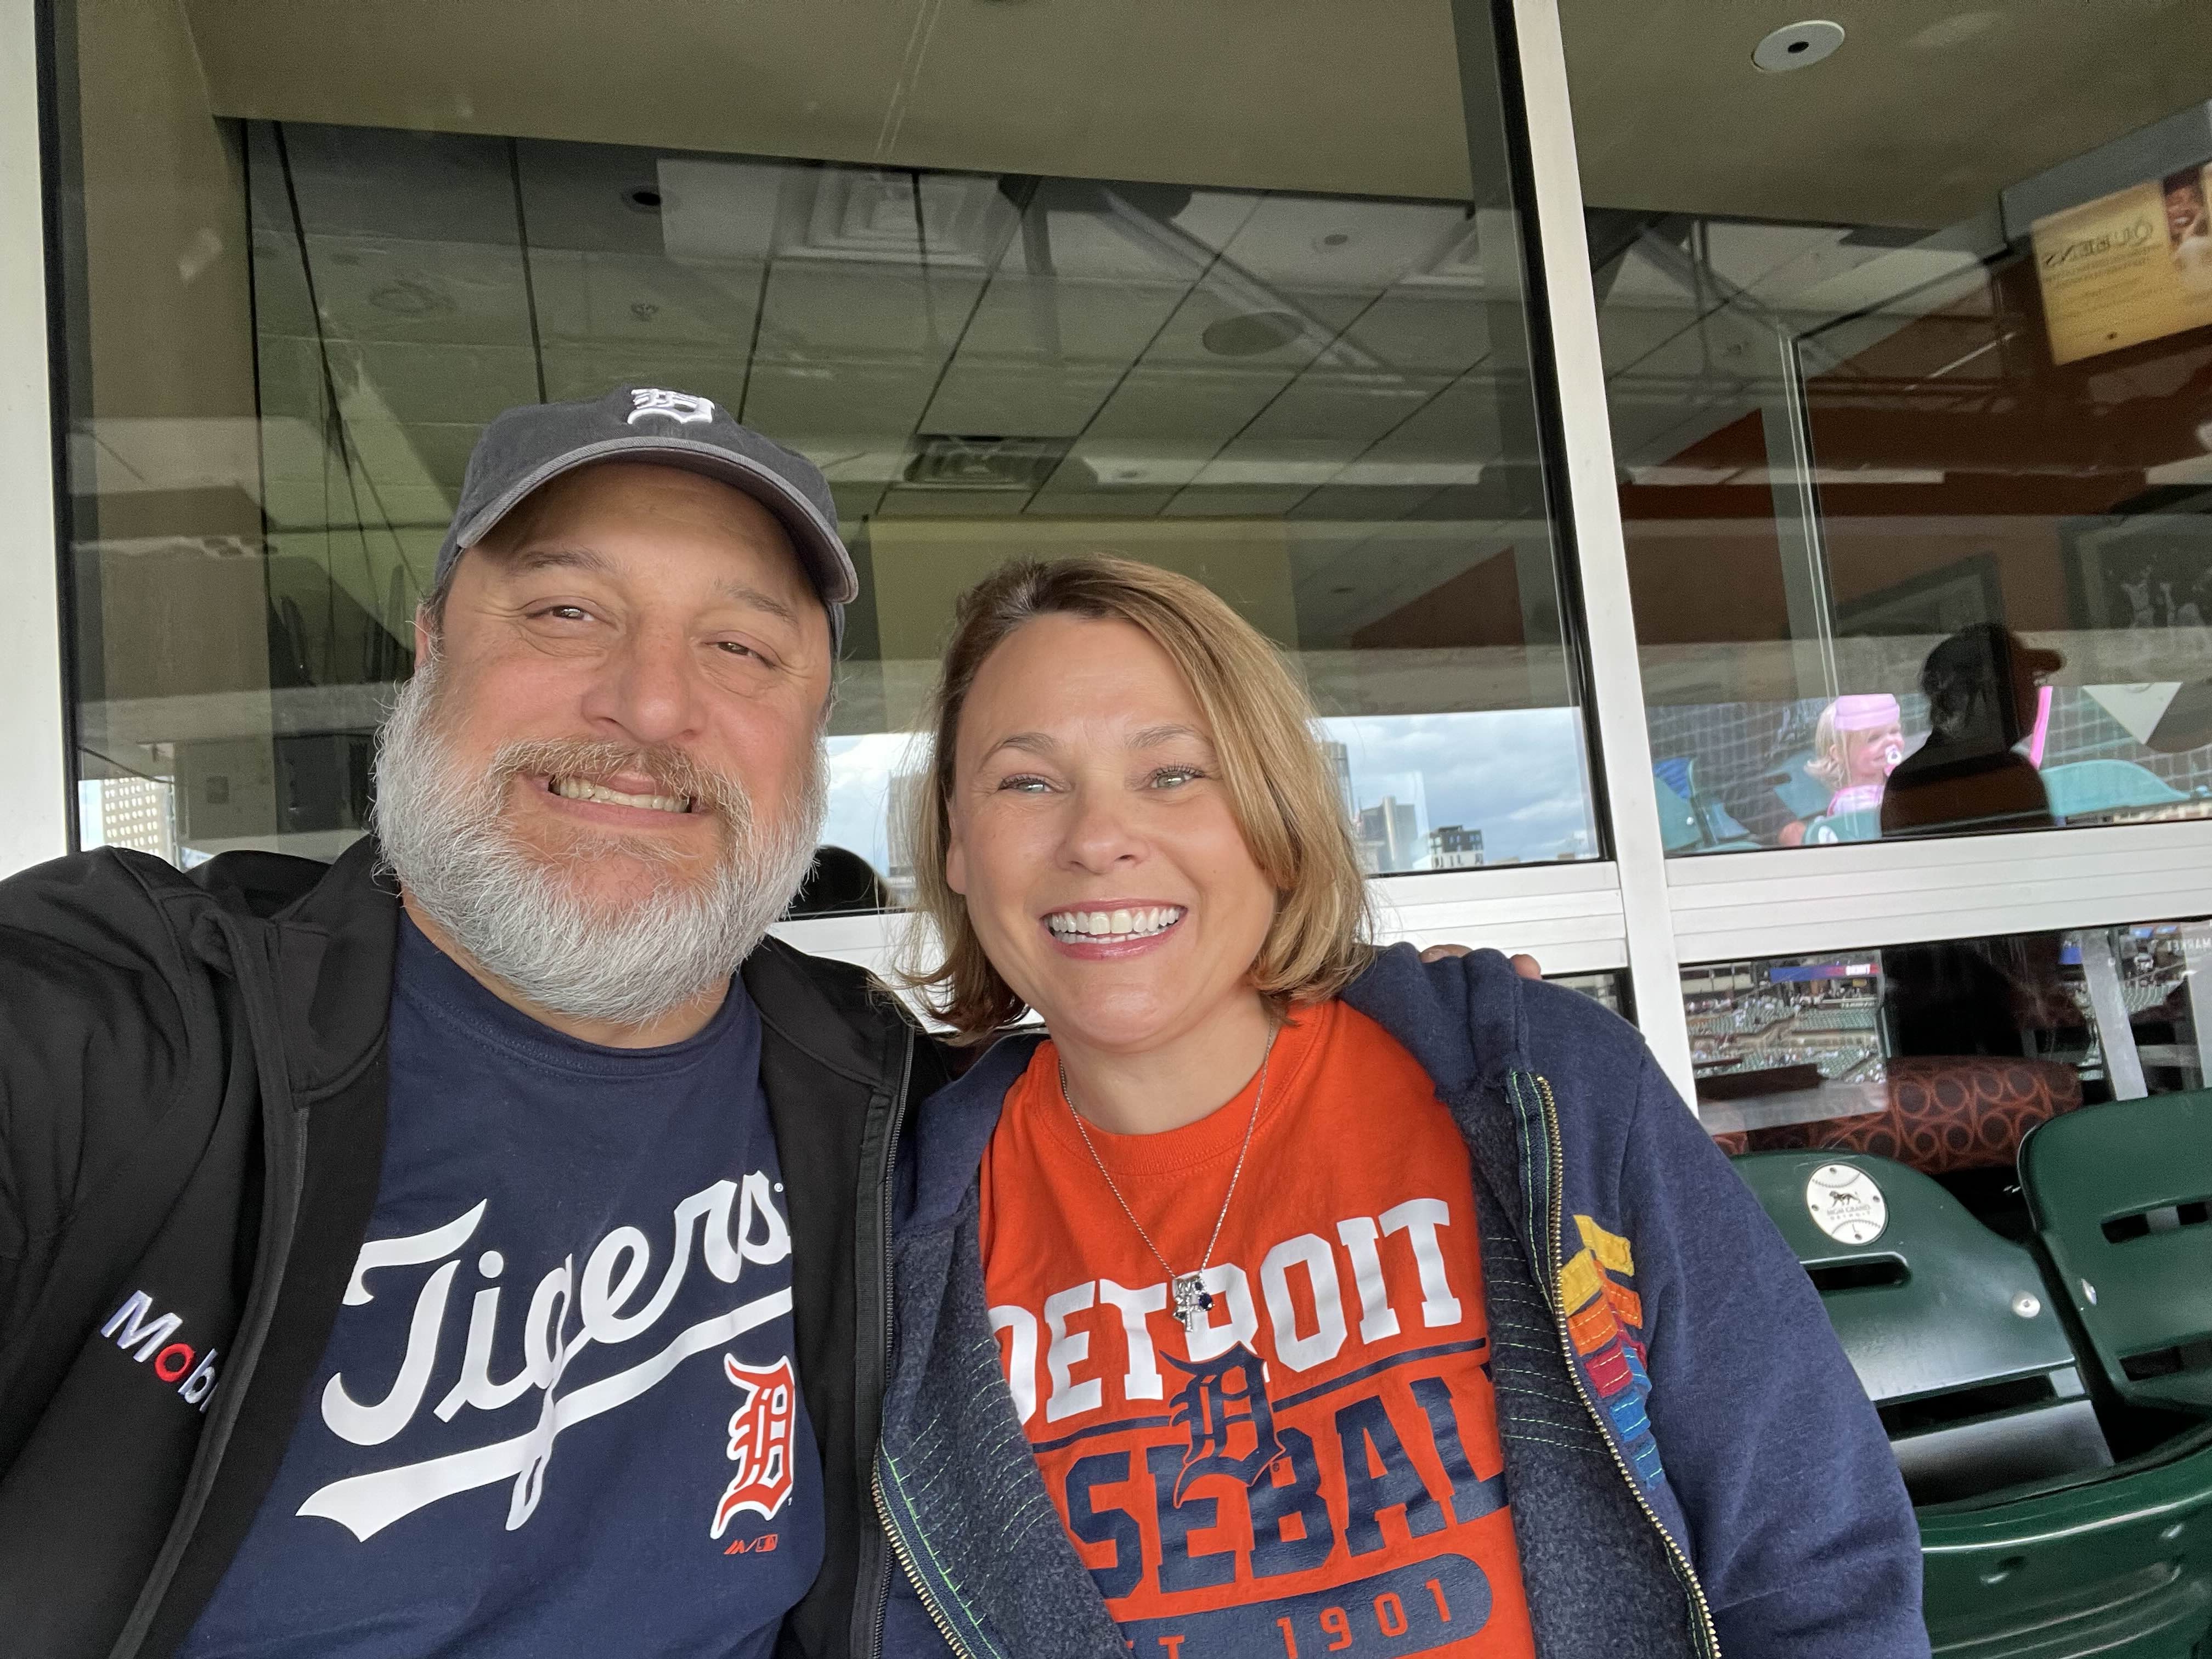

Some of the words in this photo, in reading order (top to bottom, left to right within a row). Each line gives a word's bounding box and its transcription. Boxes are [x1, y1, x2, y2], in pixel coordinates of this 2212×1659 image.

[321, 1171, 792, 1531] Tigers
[710, 1353, 795, 1539] D
[1065, 1361, 1510, 1598] SEBAL
[1277, 1579, 1451, 1658] 1901
